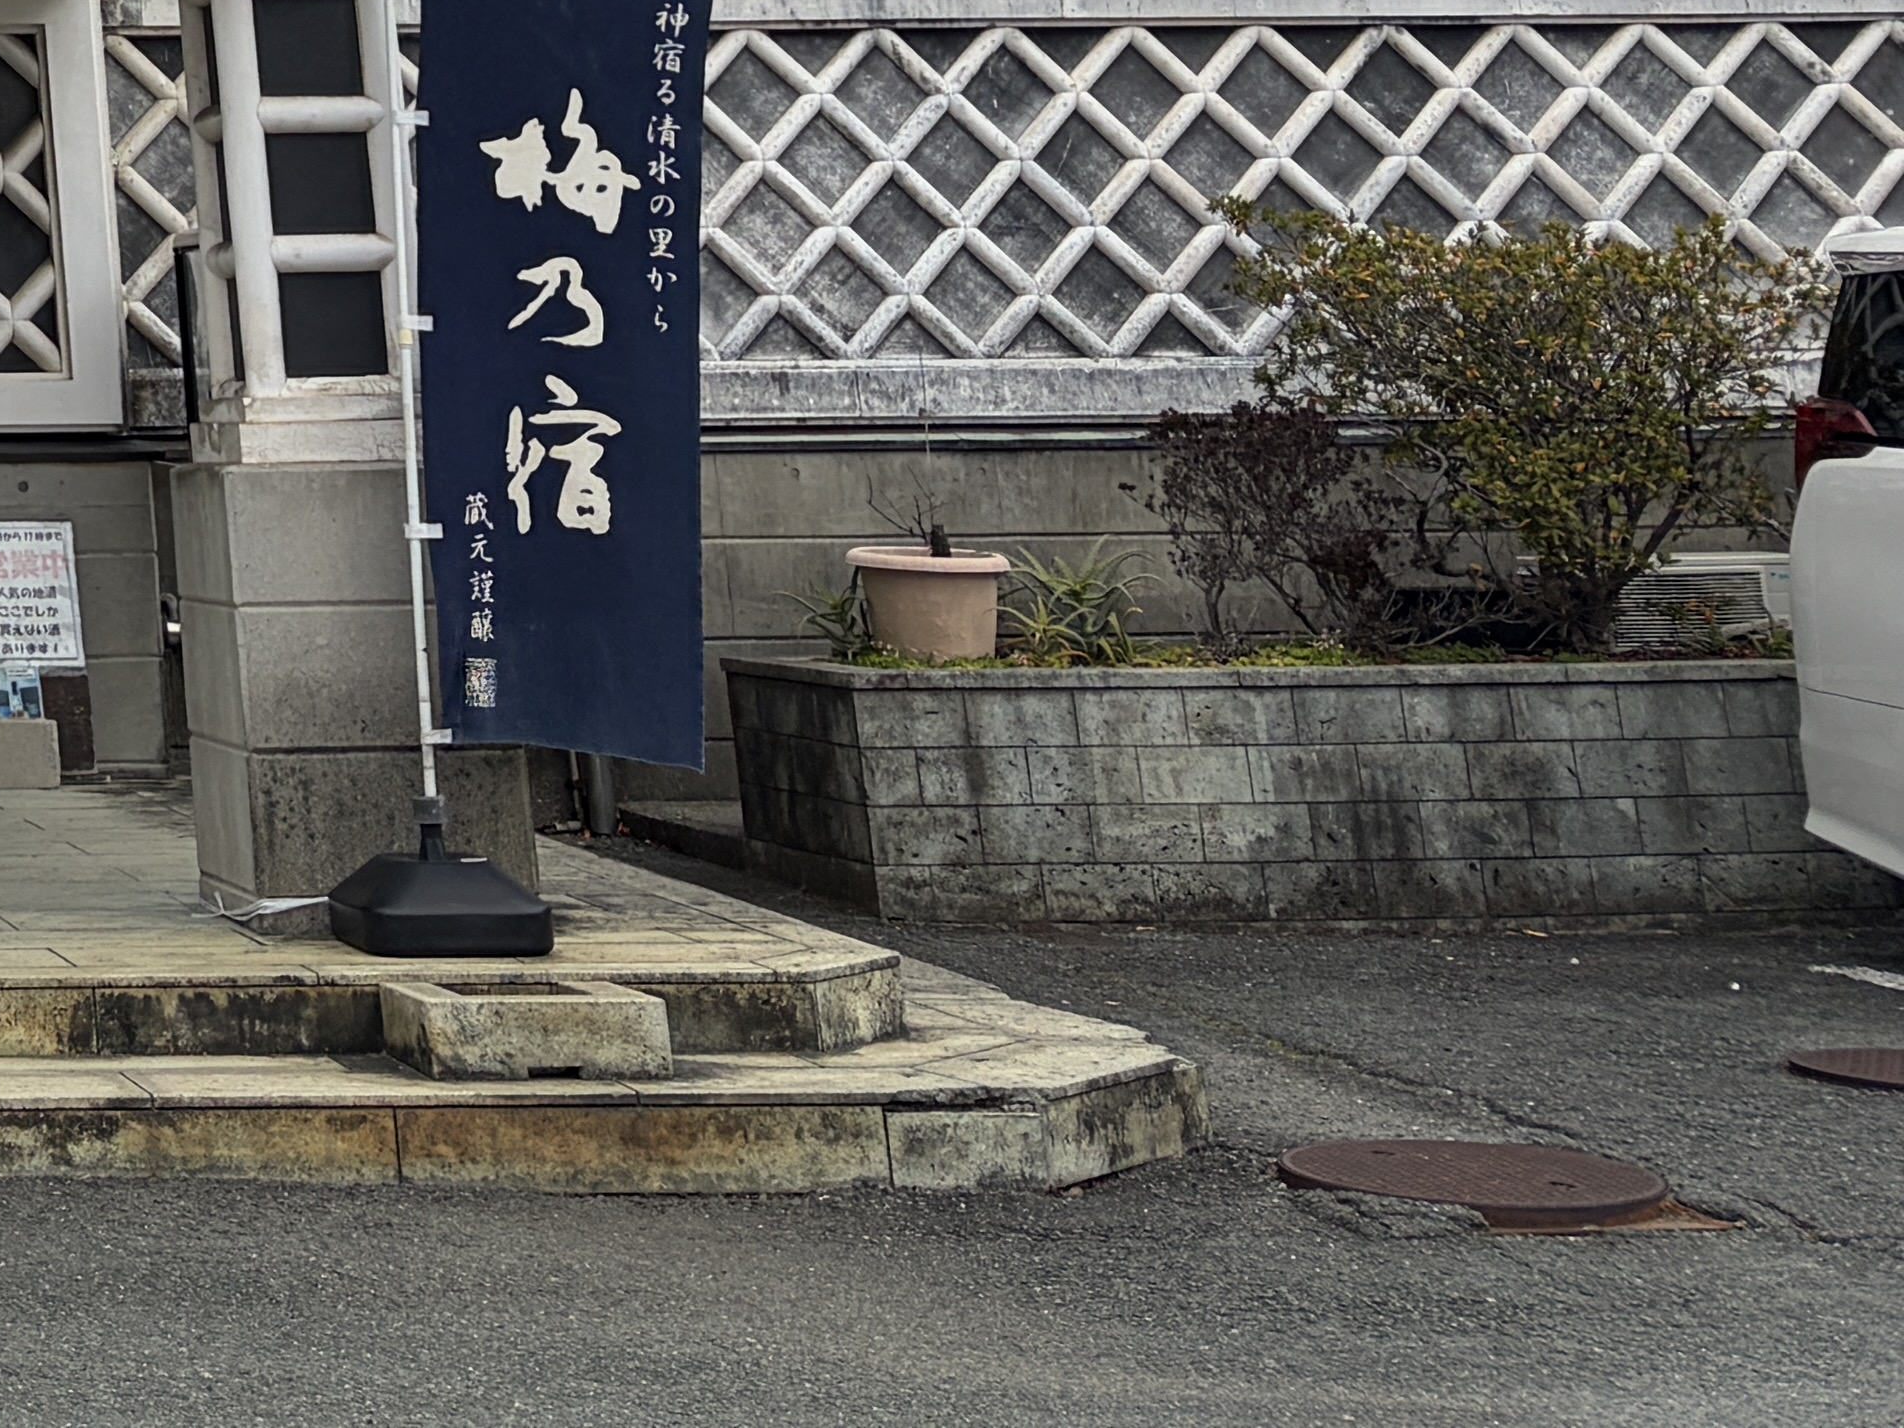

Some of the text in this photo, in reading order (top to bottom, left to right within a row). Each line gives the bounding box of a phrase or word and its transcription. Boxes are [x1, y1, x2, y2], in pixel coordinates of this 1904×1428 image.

[479, 87, 641, 536] 梅乃宿
[646, 2, 690, 334] 神宿る清水の里から
